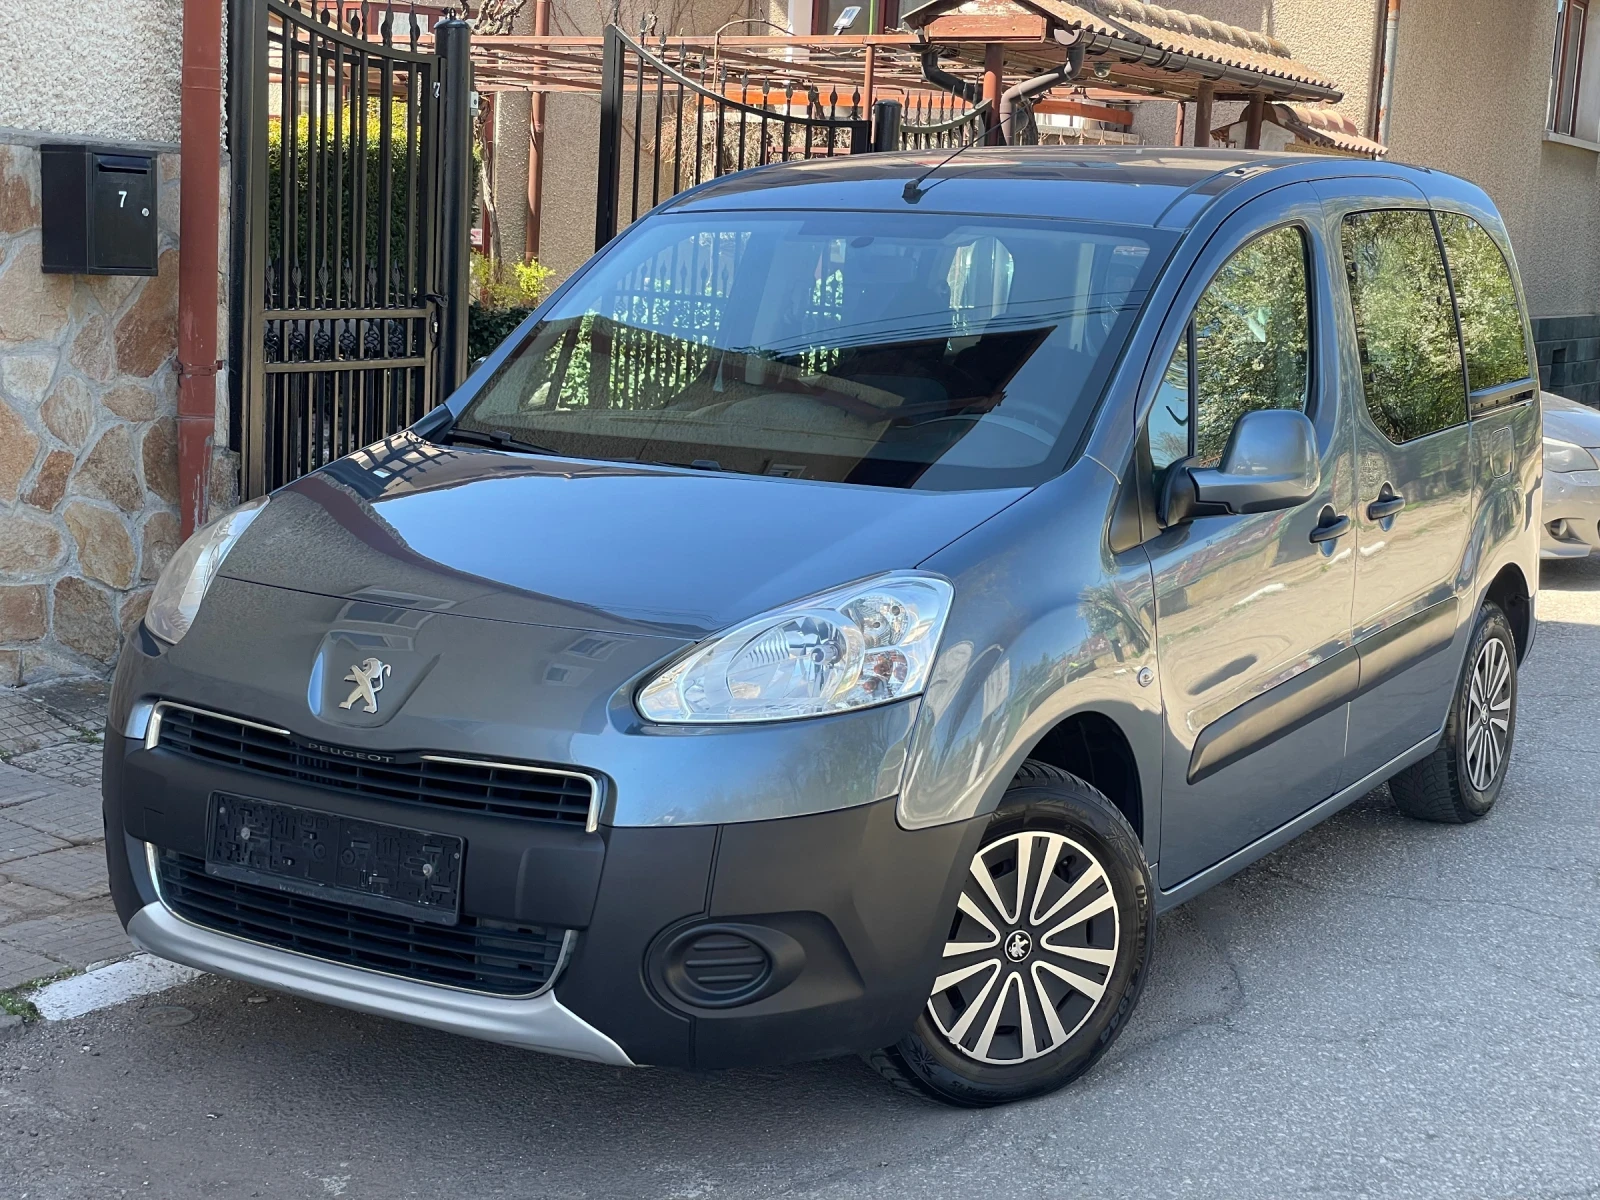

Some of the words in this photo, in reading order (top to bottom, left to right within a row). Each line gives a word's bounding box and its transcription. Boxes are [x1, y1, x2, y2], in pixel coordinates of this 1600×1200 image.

[118, 190, 128, 208] 7
[308, 743, 394, 763] PEUGEOT
[1100, 984, 1137, 1044] S944
